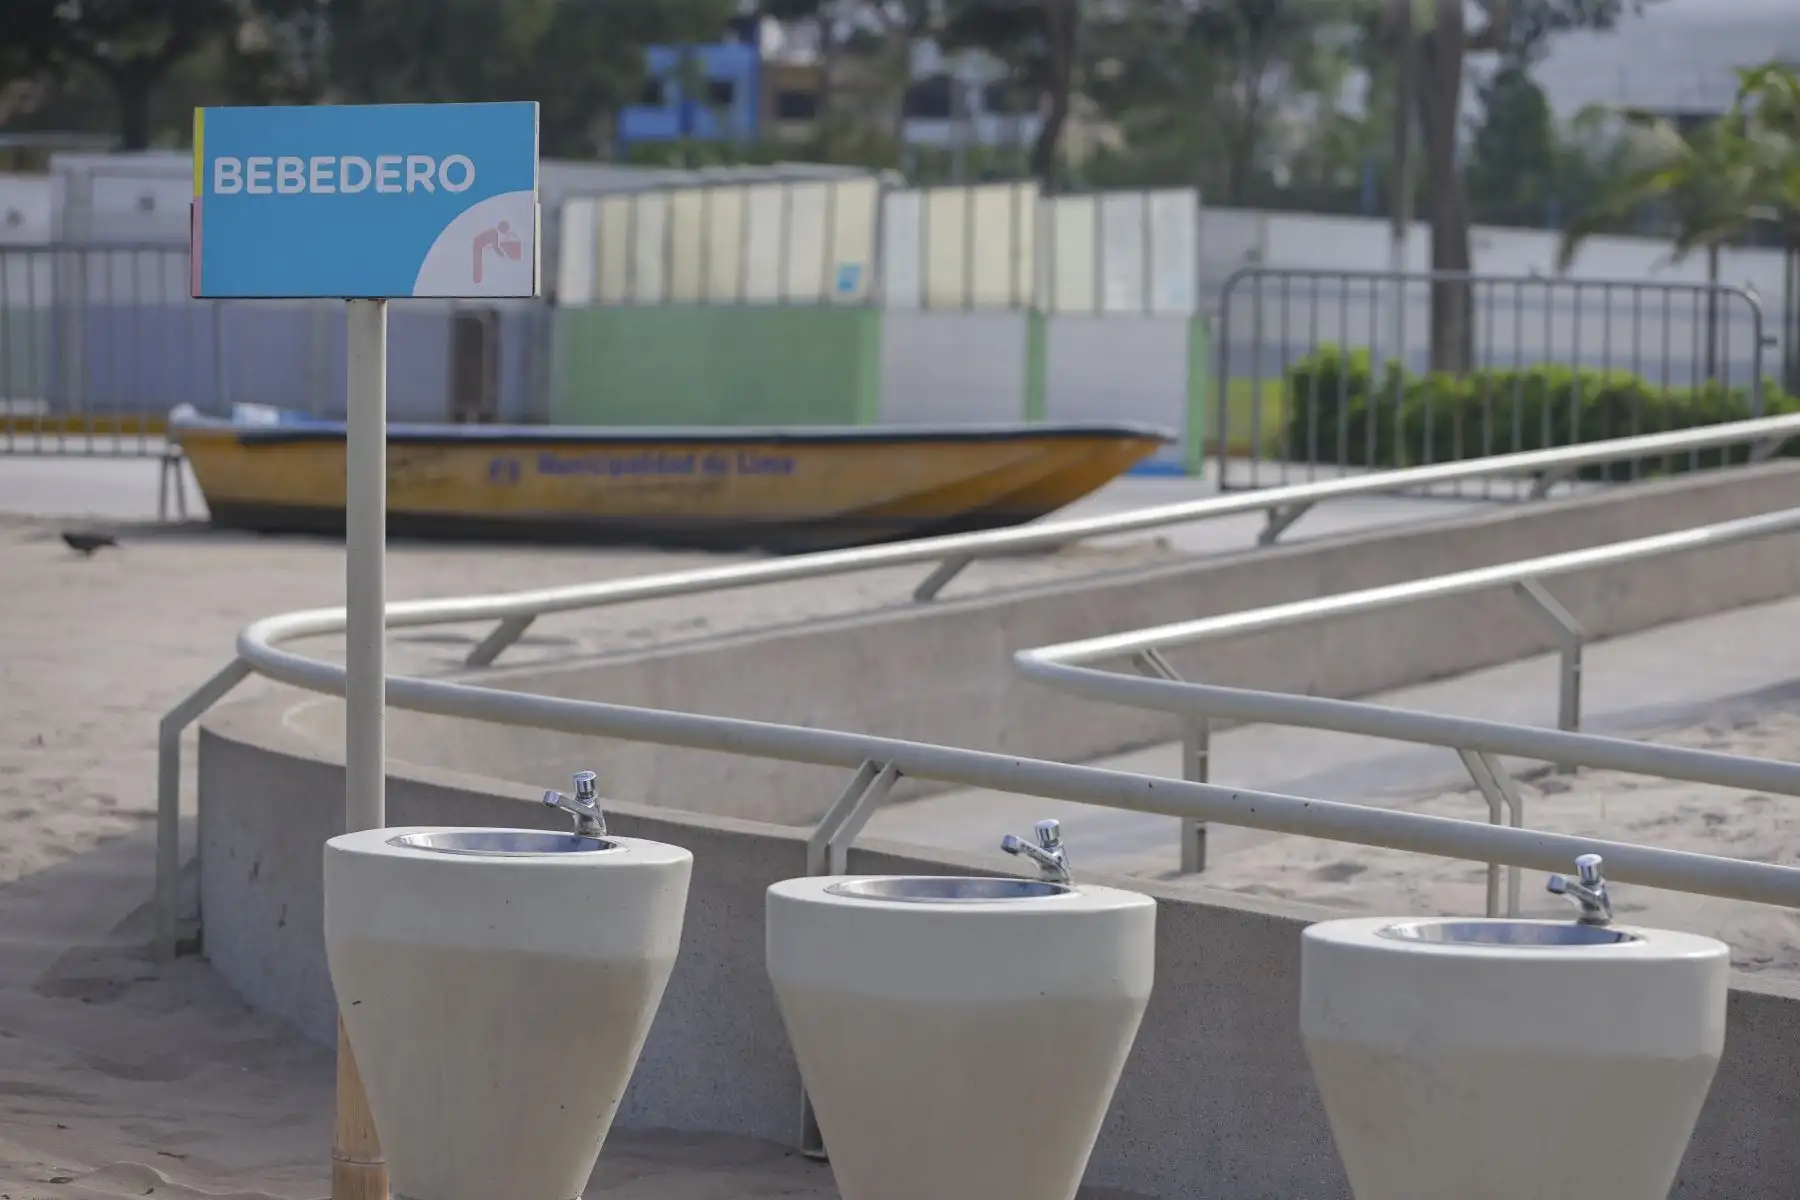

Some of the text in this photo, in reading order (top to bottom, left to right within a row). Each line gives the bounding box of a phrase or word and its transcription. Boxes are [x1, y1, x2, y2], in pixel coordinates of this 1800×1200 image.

[213, 154, 476, 195] BEBEDERO
[537, 453, 795, 476] Municipalidad de Lima
